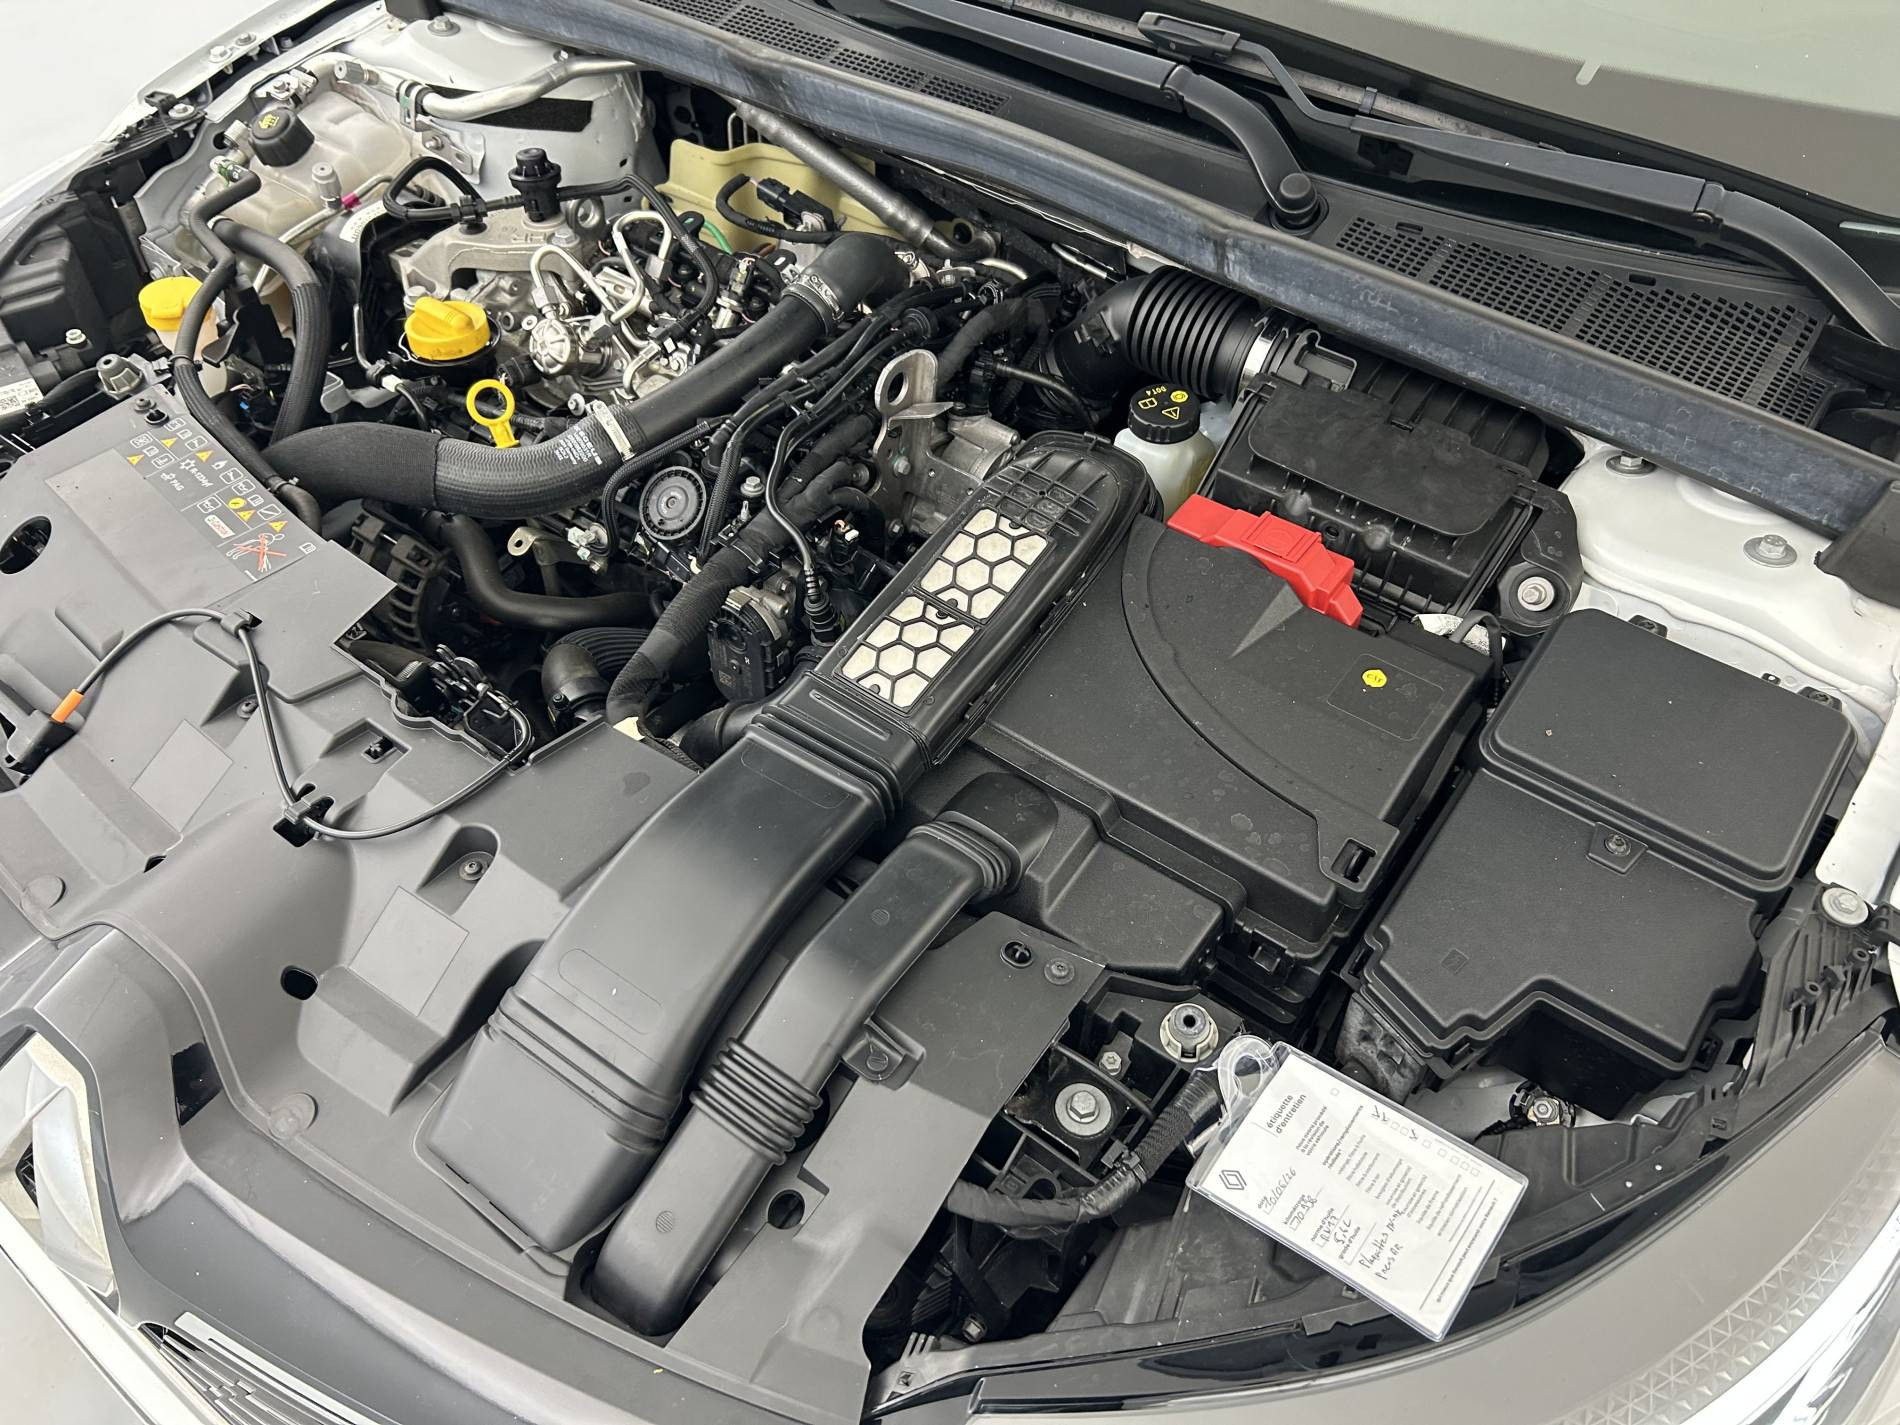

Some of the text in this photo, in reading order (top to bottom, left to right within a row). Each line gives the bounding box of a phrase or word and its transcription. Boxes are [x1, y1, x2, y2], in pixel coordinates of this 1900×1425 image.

[1152, 386, 1167, 395] DOT
[172, 479, 184, 491] PAG
[1266, 1095, 1293, 1128] étiquette
[1275, 1094, 1306, 1133] d'entretien
[1310, 1207, 1334, 1241] norme d'huile
[1338, 1226, 1360, 1259] grade d'huile
